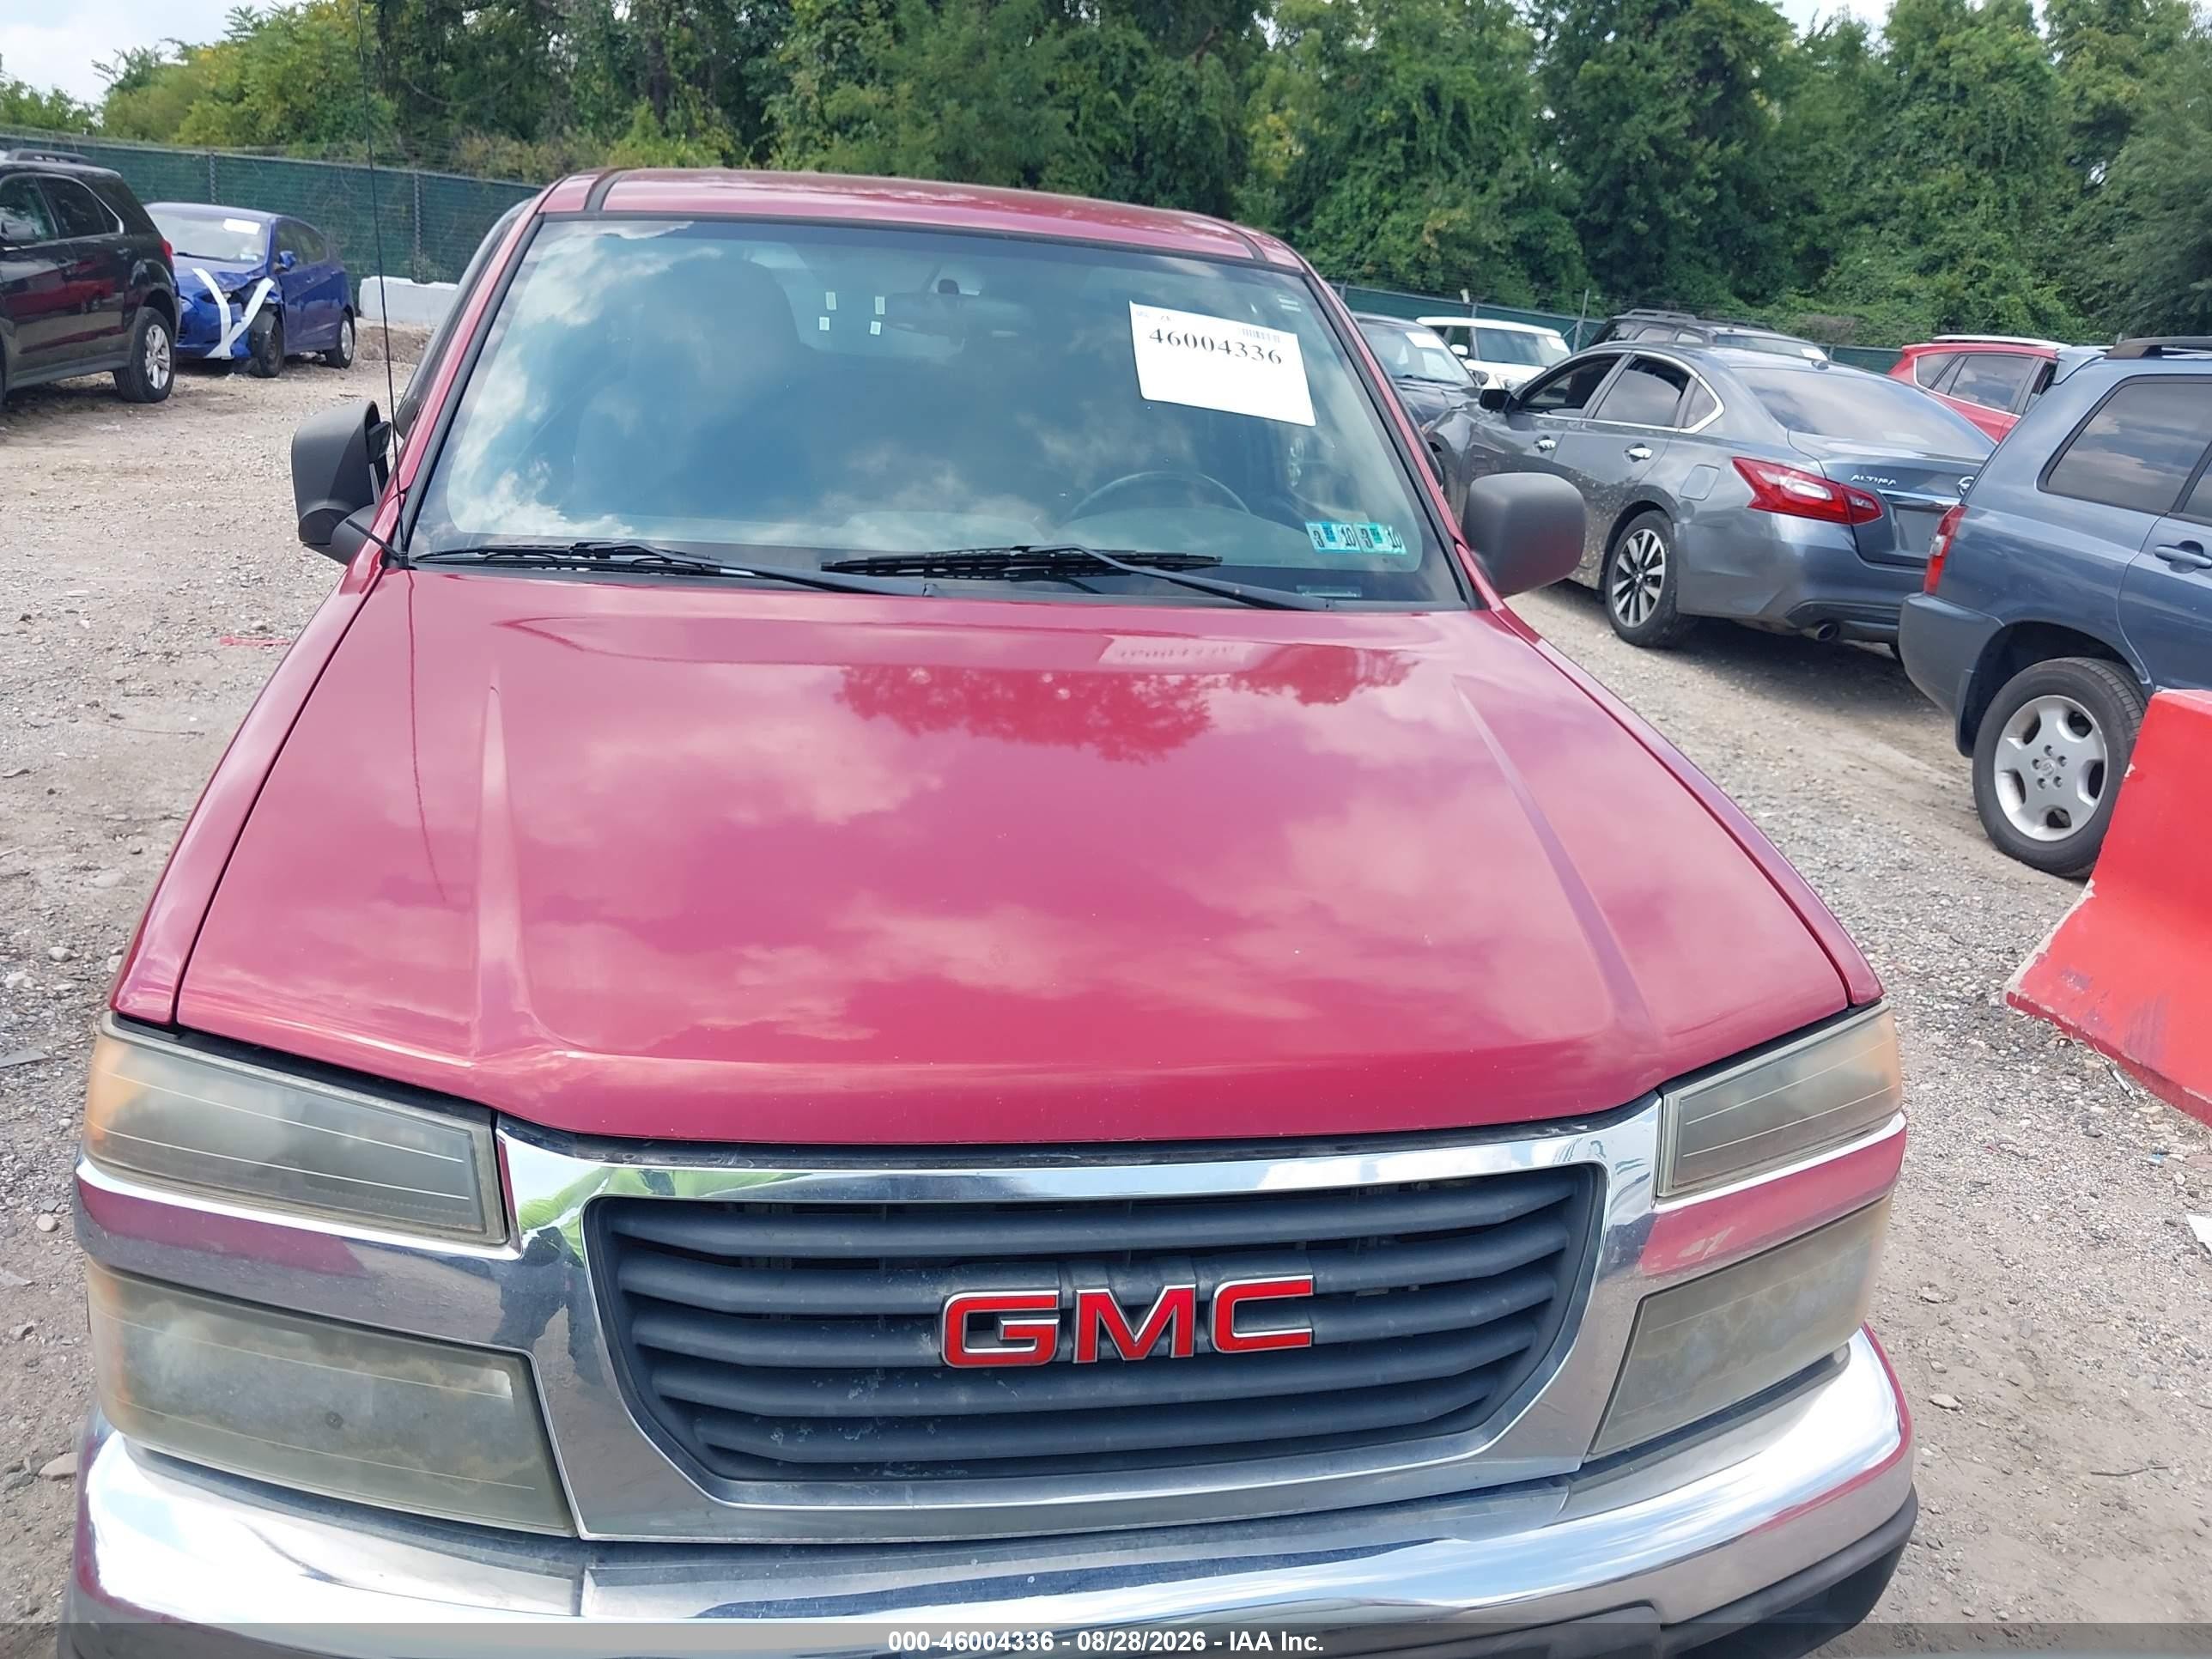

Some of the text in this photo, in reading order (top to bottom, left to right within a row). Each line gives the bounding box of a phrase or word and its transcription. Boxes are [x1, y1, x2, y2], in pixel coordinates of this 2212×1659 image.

[1149, 327, 1283, 365] 46004336
[1850, 473, 1897, 486] ALTIMA
[940, 1274, 1316, 1369] GMC
